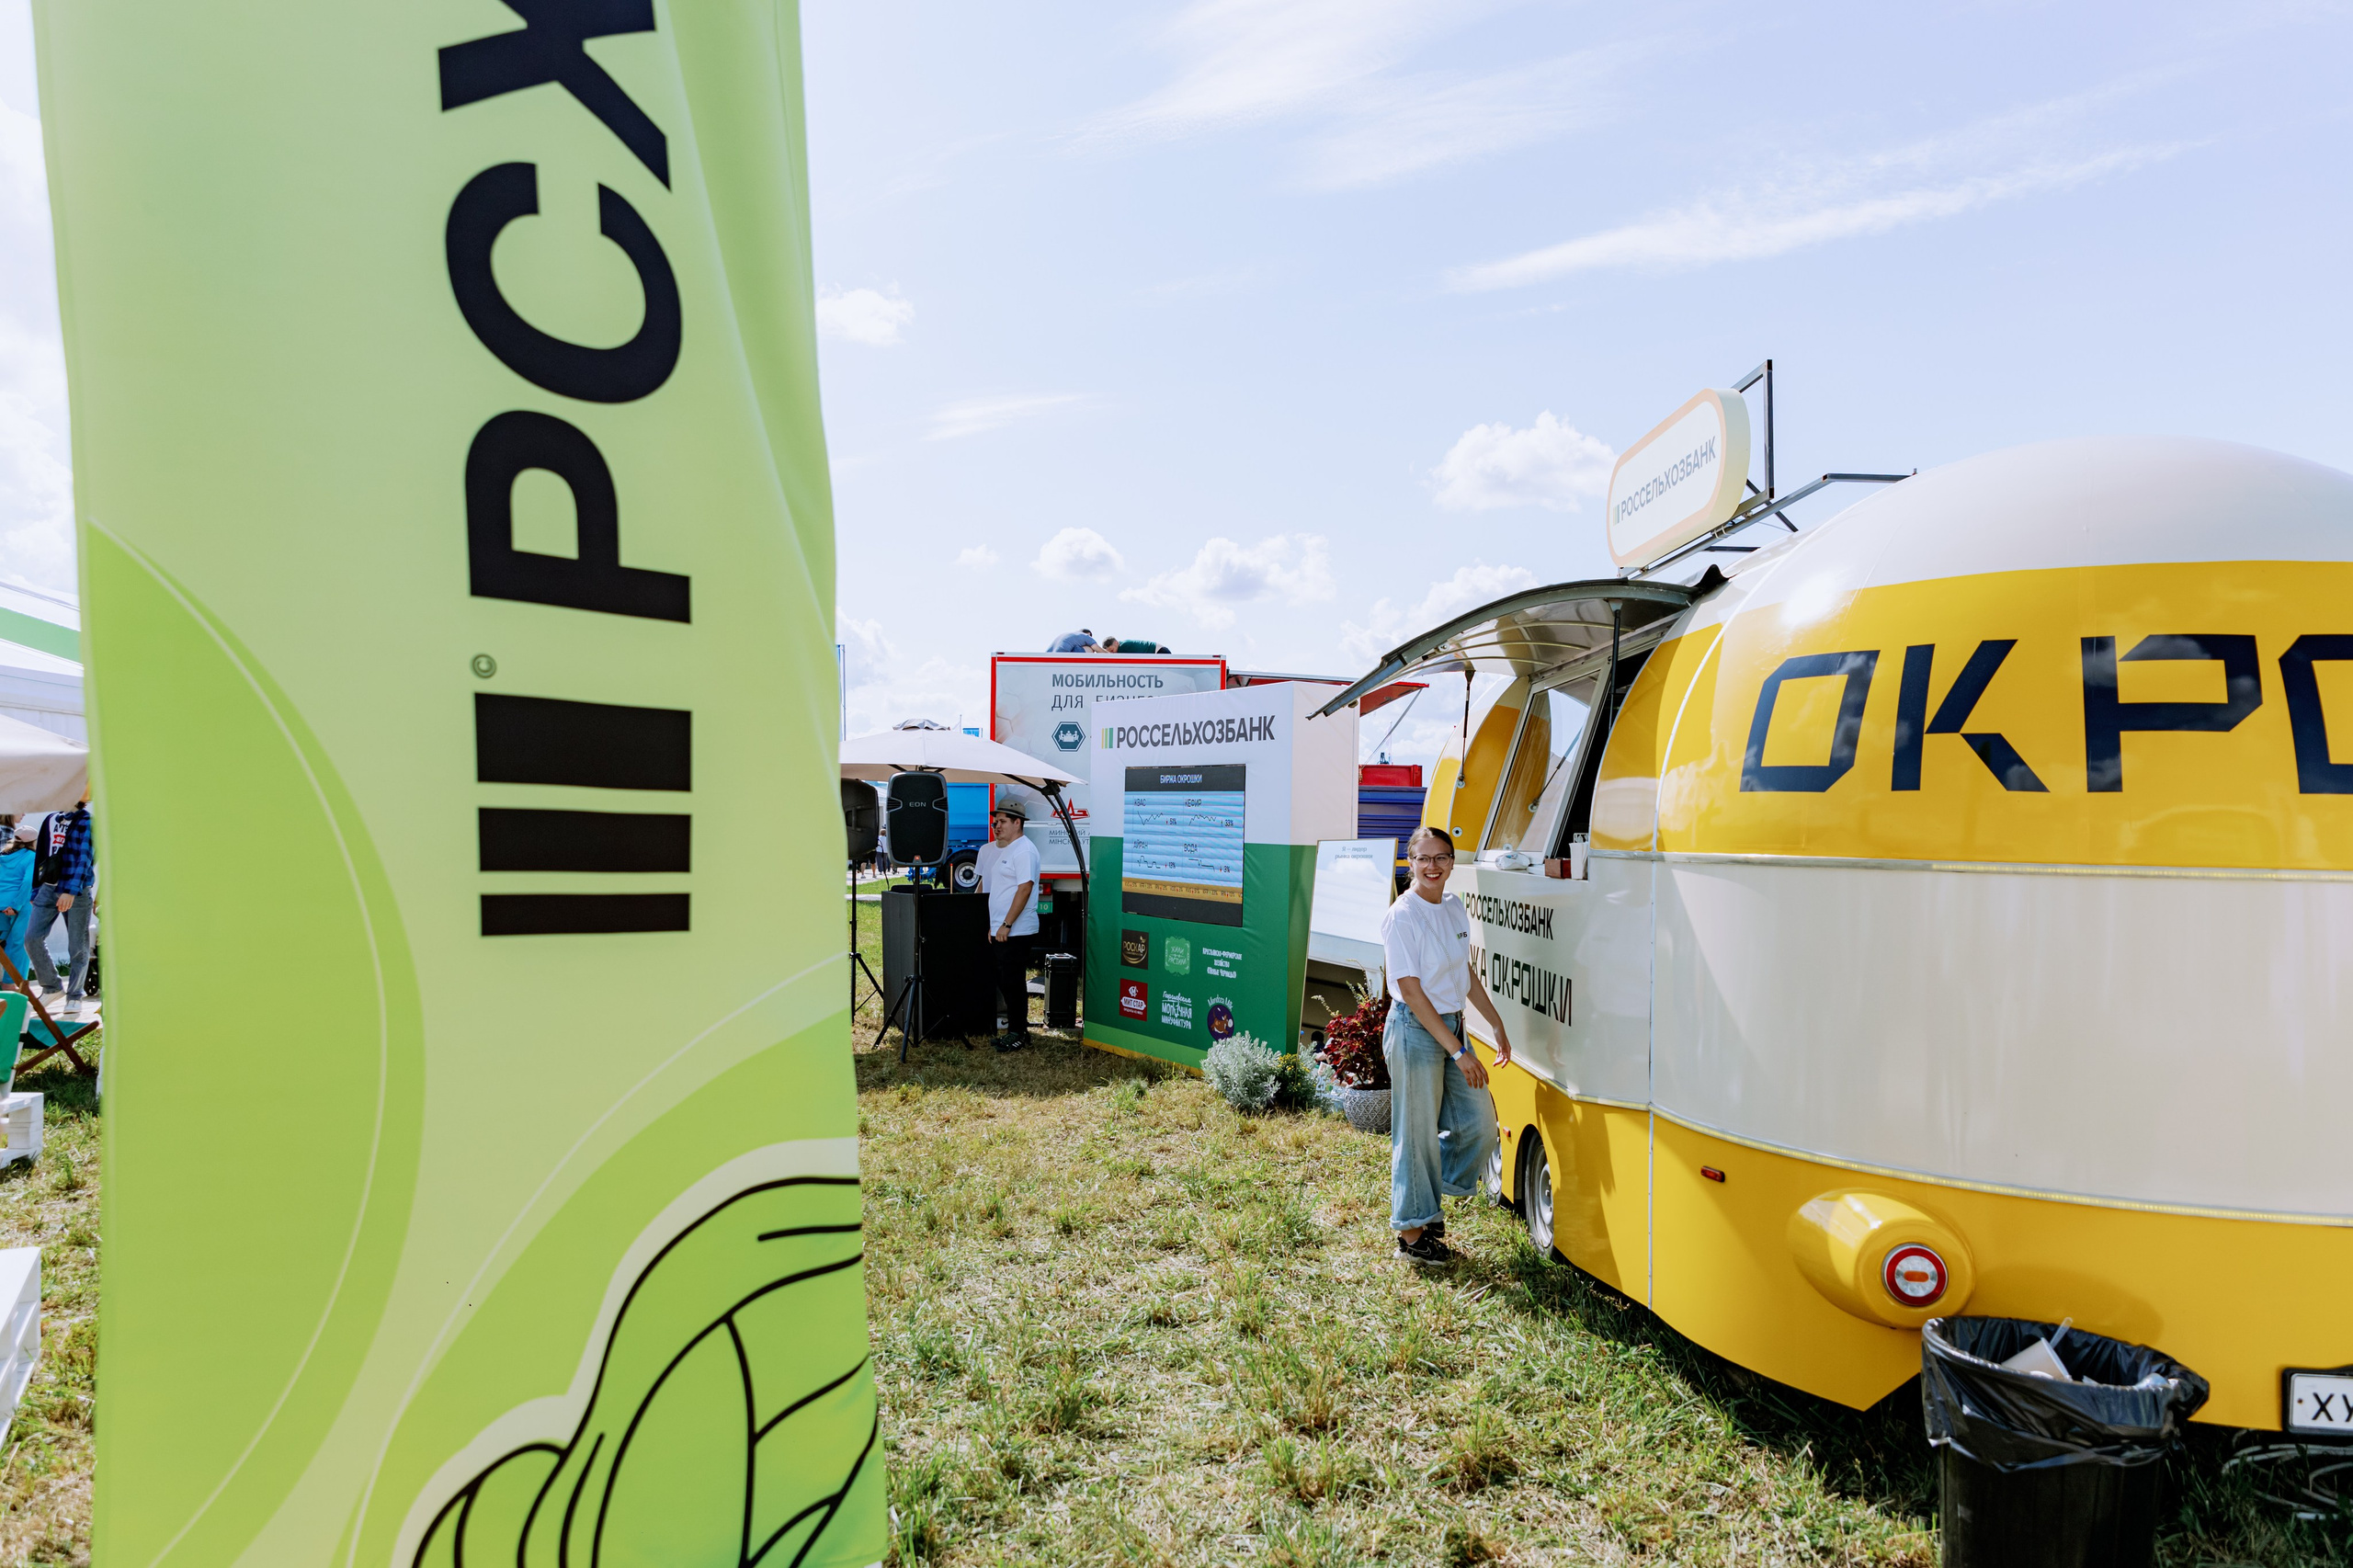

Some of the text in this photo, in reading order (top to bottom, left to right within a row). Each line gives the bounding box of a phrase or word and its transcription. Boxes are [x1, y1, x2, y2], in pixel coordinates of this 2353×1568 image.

[1620, 436, 1716, 521] РОССЕЛЬХОЗБАНК
[1051, 674, 1164, 688] МОБИЛЬНОСТЬ
[1051, 695, 1084, 711] ДЛЯ
[1117, 715, 1276, 749] РОССЕЛЬХОЗБАНК
[1160, 774, 1202, 784] БИРЖА ОКРОШКИ
[1134, 799, 1147, 807] КВАС
[1185, 799, 1201, 807] КЕФИР
[1184, 844, 1198, 854] ВОДА
[1466, 892, 1553, 940] РОССЕЛЬХОЗБАНК
[1123, 941, 1145, 953] РОСКАР
[1492, 952, 1573, 1028] ОКРОШКИ
[1132, 1000, 1143, 1008] СТАР
